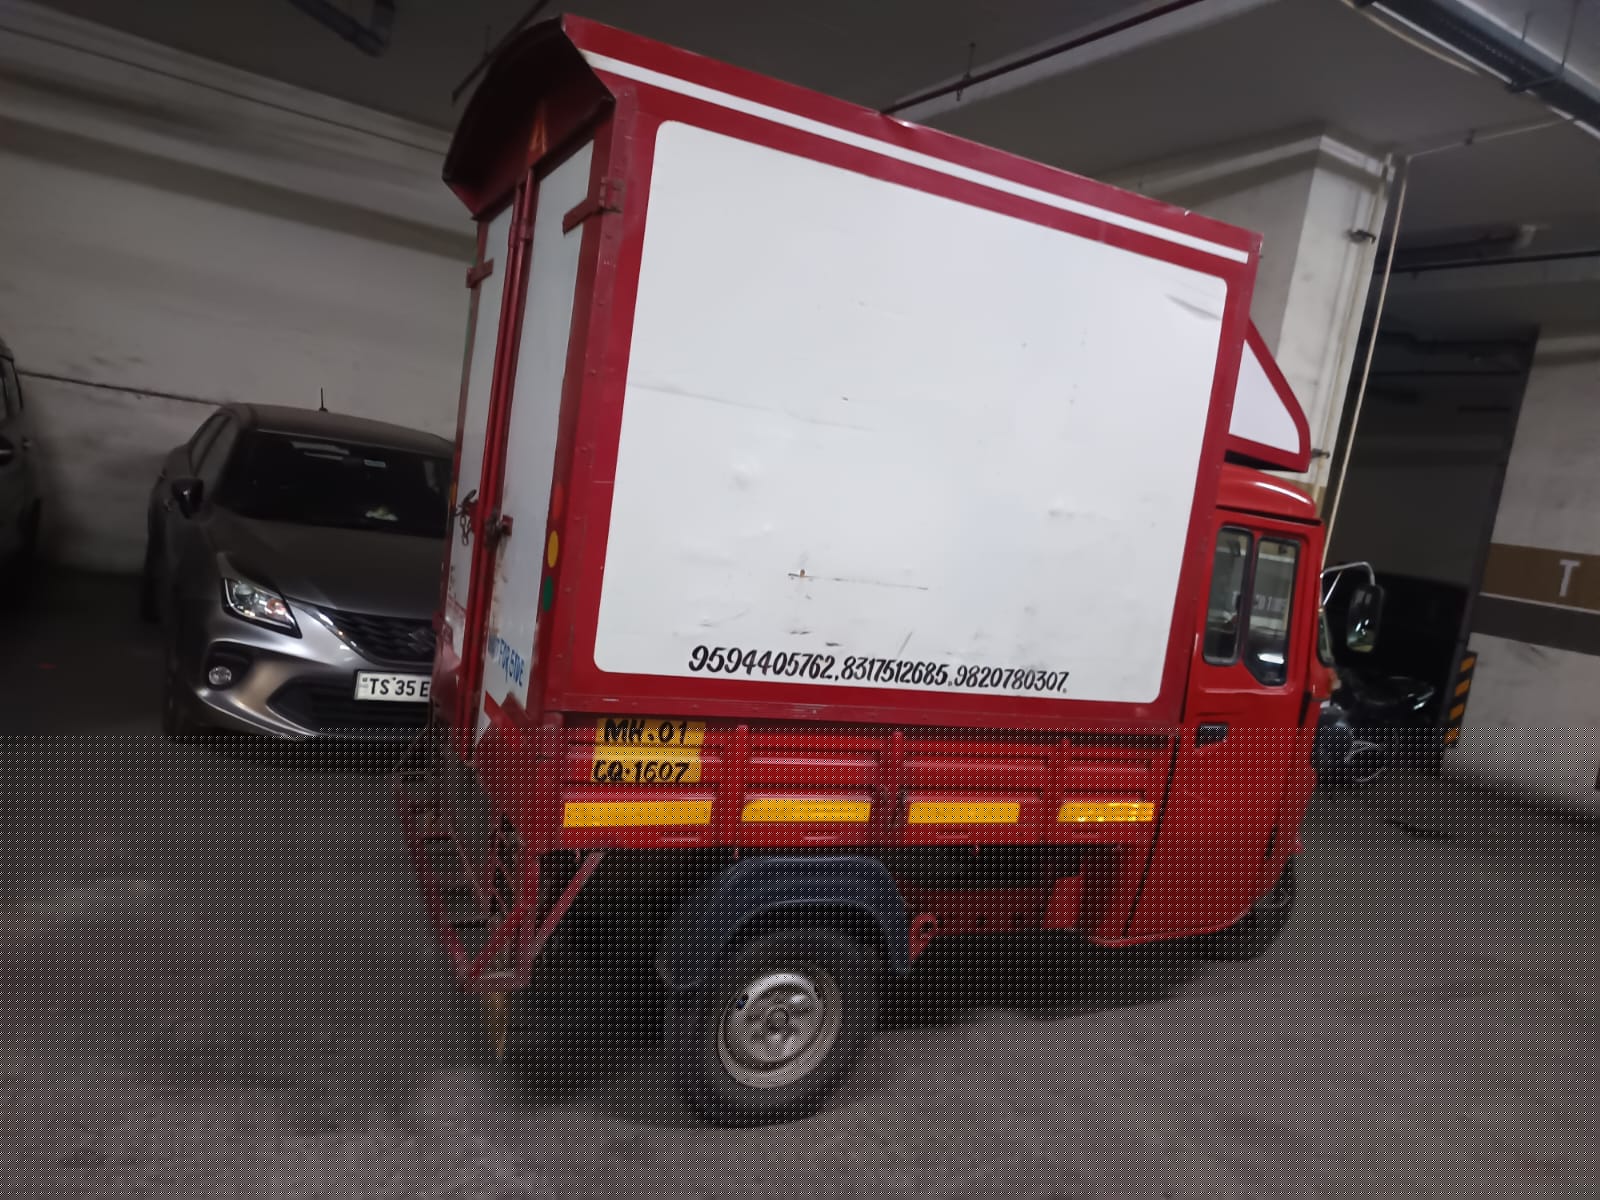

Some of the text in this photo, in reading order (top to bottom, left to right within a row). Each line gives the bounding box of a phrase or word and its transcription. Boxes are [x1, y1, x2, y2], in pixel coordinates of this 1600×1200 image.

[1559, 559, 1580, 597] T
[369, 677, 390, 695] TS
[395, 679, 417, 696] 35
